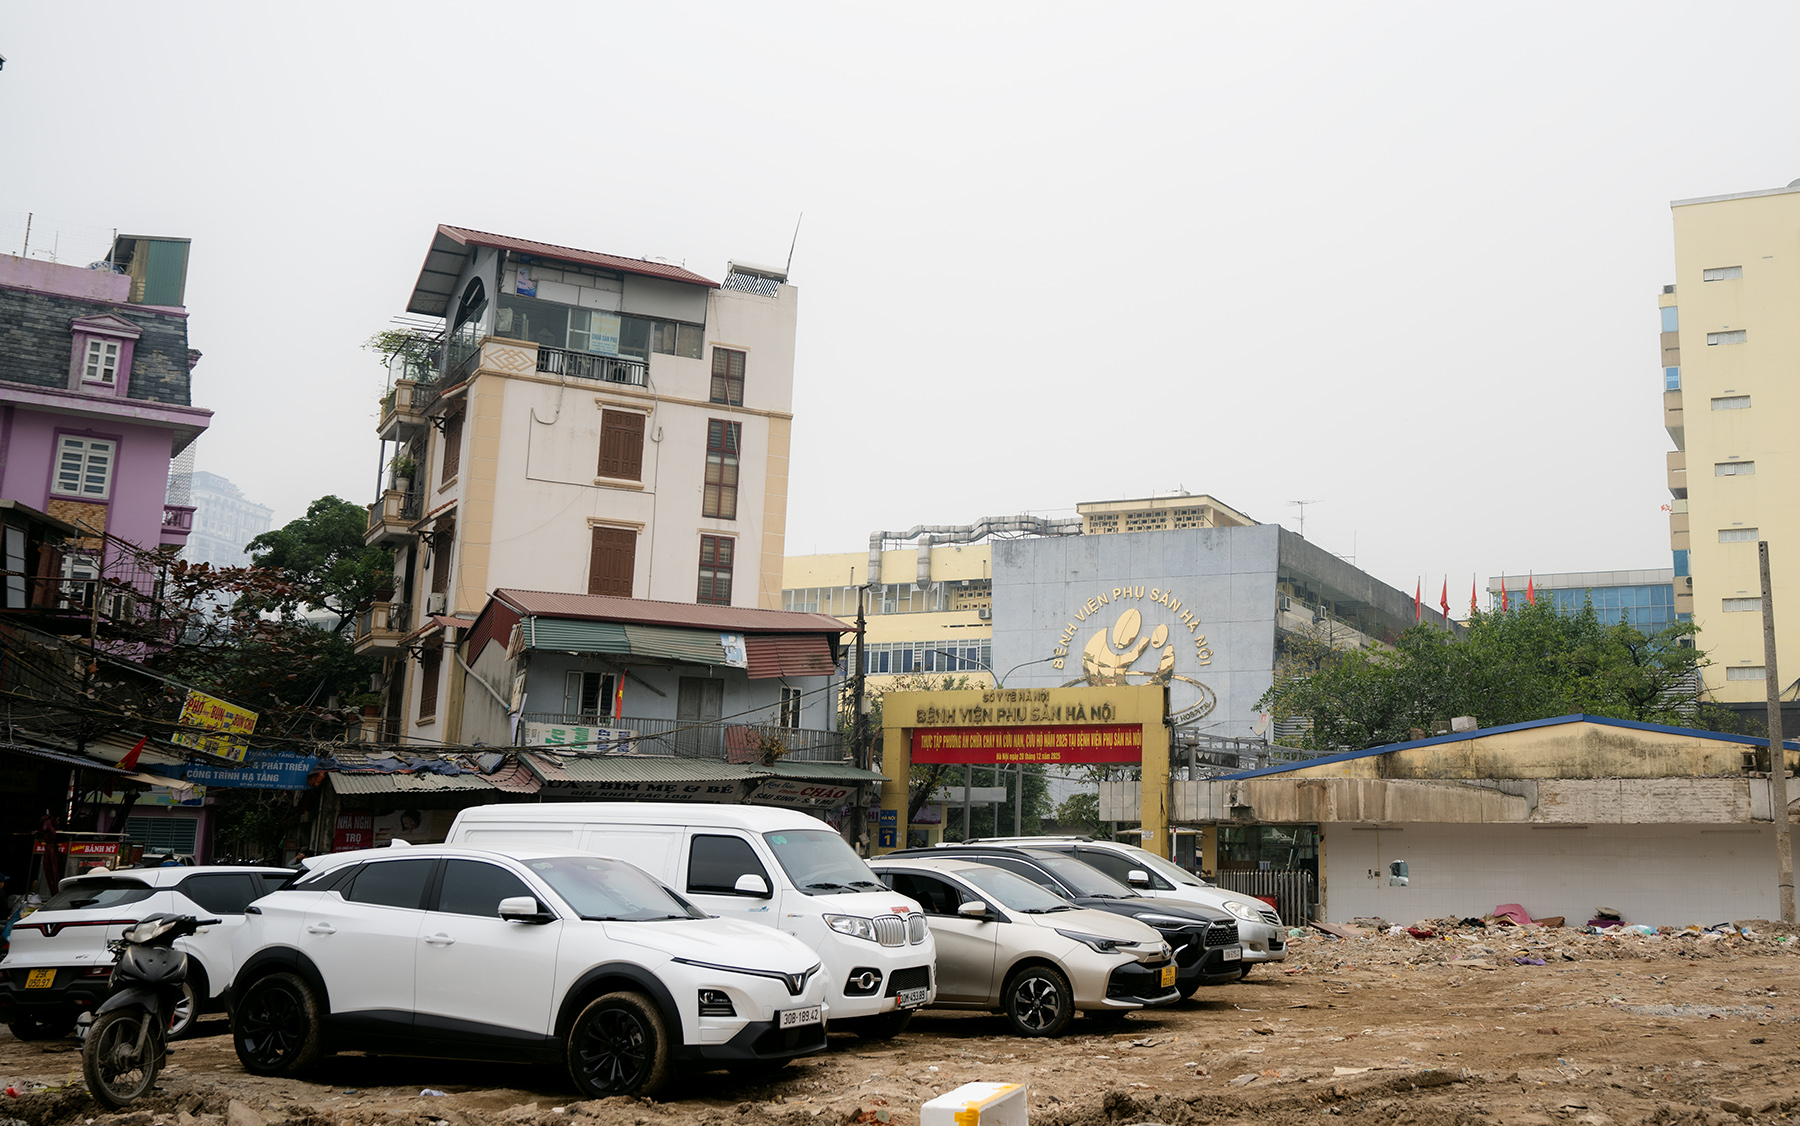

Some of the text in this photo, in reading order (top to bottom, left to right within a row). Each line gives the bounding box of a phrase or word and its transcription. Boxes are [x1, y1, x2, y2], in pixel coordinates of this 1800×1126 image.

[1053, 586, 1214, 670] BỆNH VIỆN PHỤ SẢN HÀ NỘI
[997, 692, 1003, 702] Y
[1034, 689, 1050, 703] NỘI
[916, 701, 1116, 725] BỆNH VIỆN PHỤ SẢN HÀ NỘI
[1180, 701, 1213, 723] HOSPITAL
[545, 728, 566, 744] Trà
[921, 733, 933, 751] THỰC
[934, 732, 942, 751] TẬP
[943, 733, 961, 749] PHƯƠNG
[962, 732, 969, 748] ÁN
[970, 732, 982, 748] CHỮA
[983, 731, 995, 748] CHÁY
[996, 731, 1002, 748] VÀ
[1036, 731, 1043, 751] HỘ
[1044, 731, 1055, 748] NĂM
[1056, 733, 1068, 748] 2025
[1077, 730, 1090, 750] BỆNH
[1091, 730, 1102, 750] VIỆN
[1103, 732, 1113, 750] PHỤ
[1114, 728, 1124, 747] SẢN
[1125, 729, 1132, 747] HÀ
[1133, 729, 1142, 749] NỘI
[1010, 752, 1019, 761] ngày
[1025, 752, 1036, 761] tháng
[1037, 752, 1041, 760] 12
[1042, 752, 1050, 760] năm
[1051, 752, 1061, 760] 2025
[262, 760, 284, 771] PHÁT
[285, 760, 309, 771] TRIỂN
[187, 767, 280, 782] CÔNG TRÌNH HẠ TẦNG
[683, 785, 701, 793] &
[706, 784, 733, 793] BÉ
[765, 780, 781, 789] Hoa
[800, 787, 848, 799] CHÁO
[345, 833, 362, 845] TRỌ
[884, 834, 890, 846] 1
[84, 844, 105, 853] BÁNH
[783, 1008, 819, 1026] 30B-189.42
